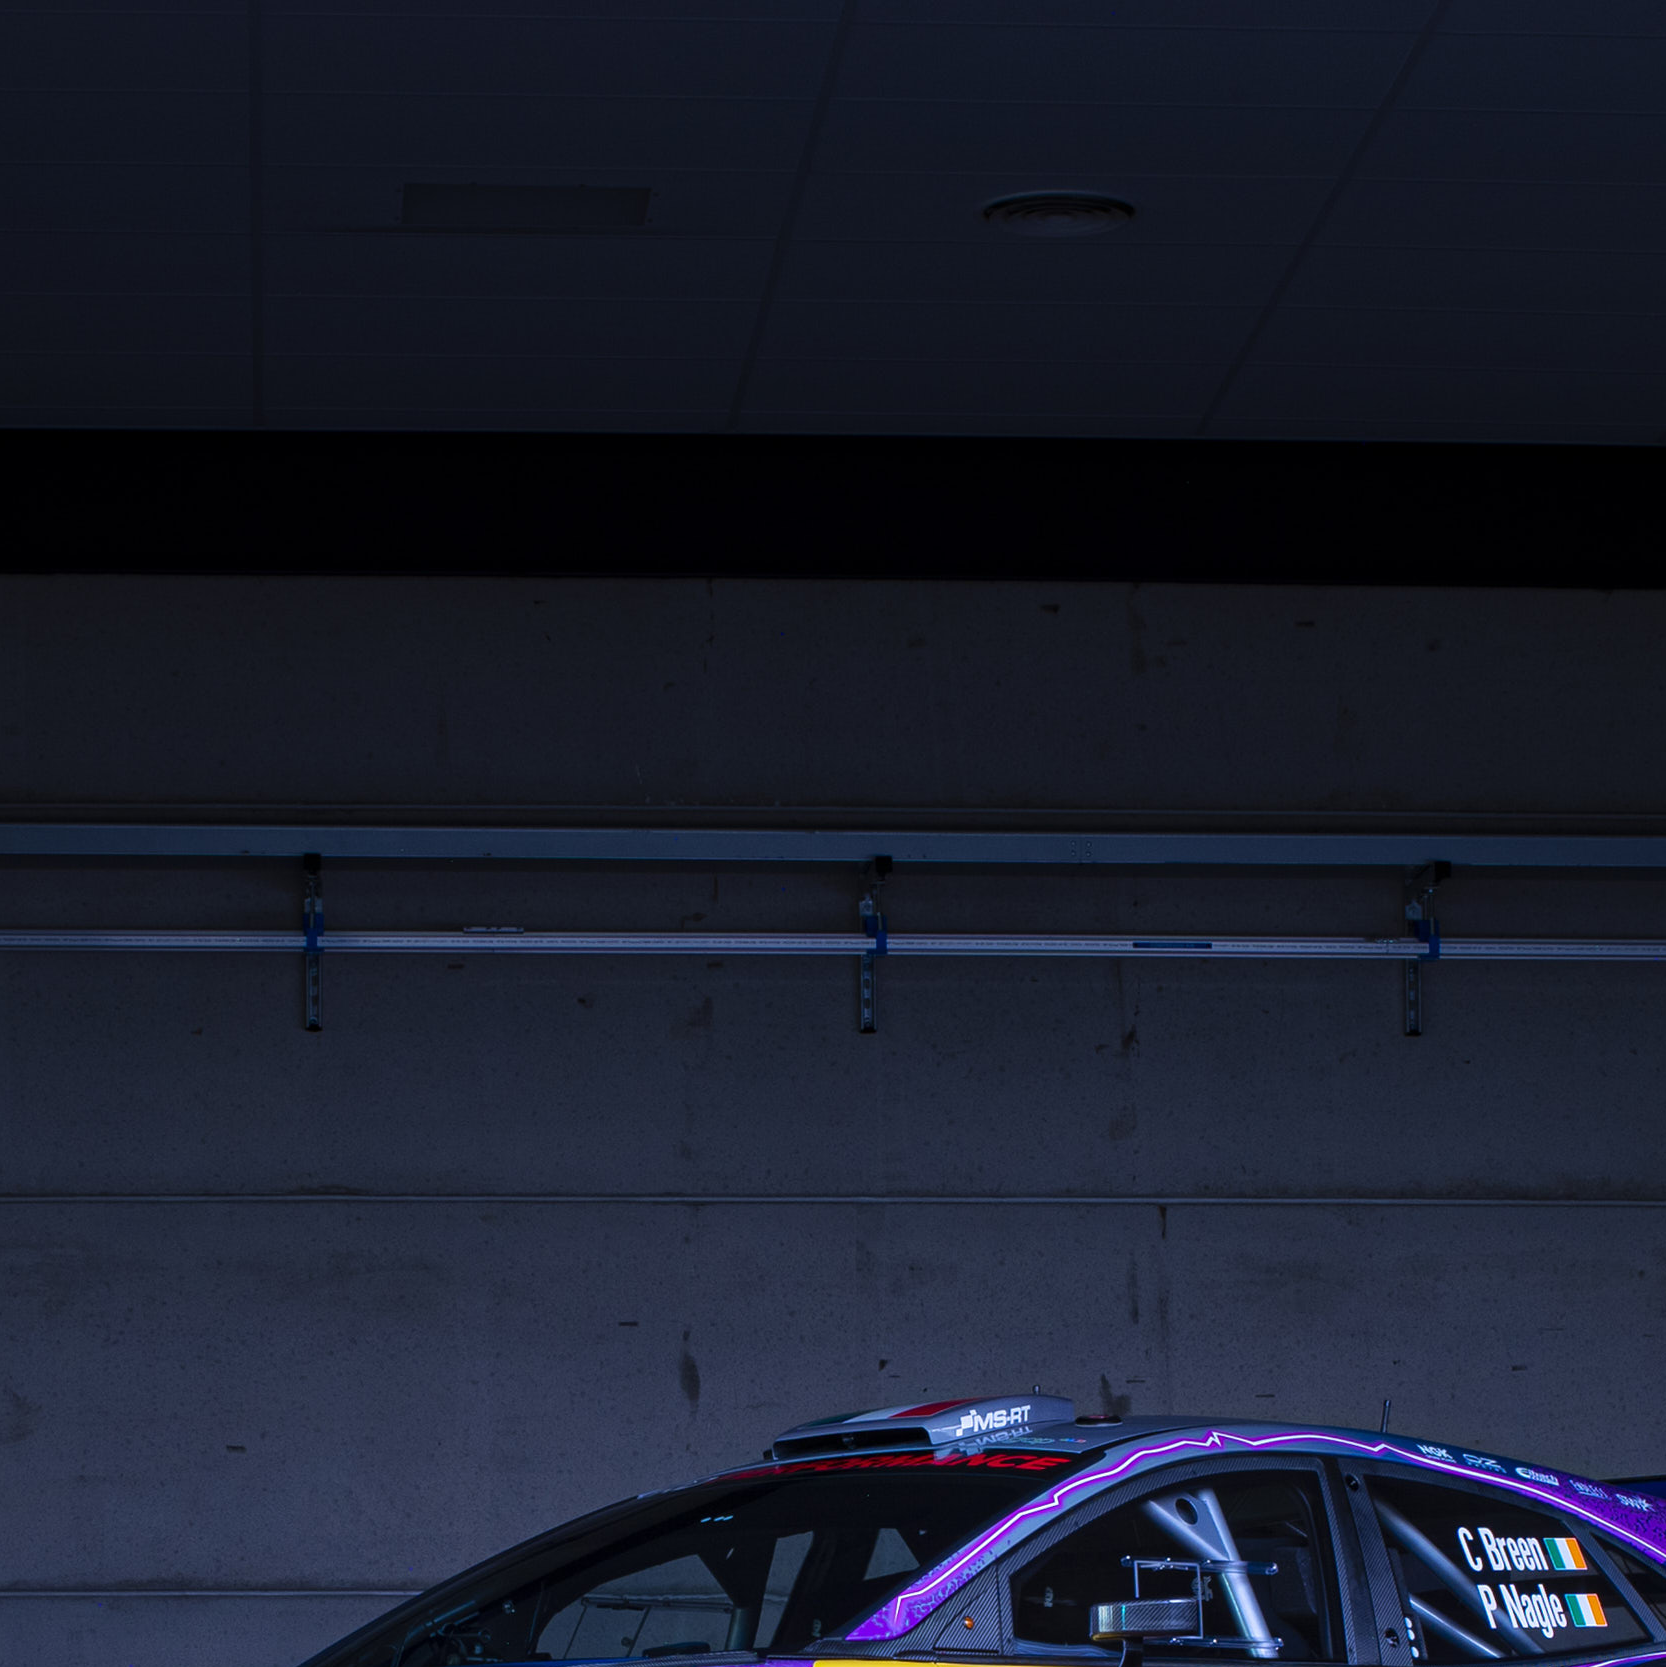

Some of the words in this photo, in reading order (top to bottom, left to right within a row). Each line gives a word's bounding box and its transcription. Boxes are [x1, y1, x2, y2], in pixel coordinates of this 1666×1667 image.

[1457, 1526, 1483, 1571] C
[1477, 1527, 1549, 1571] Breen
[1477, 1584, 1497, 1629] P
[1499, 1583, 1568, 1639] Nagle
